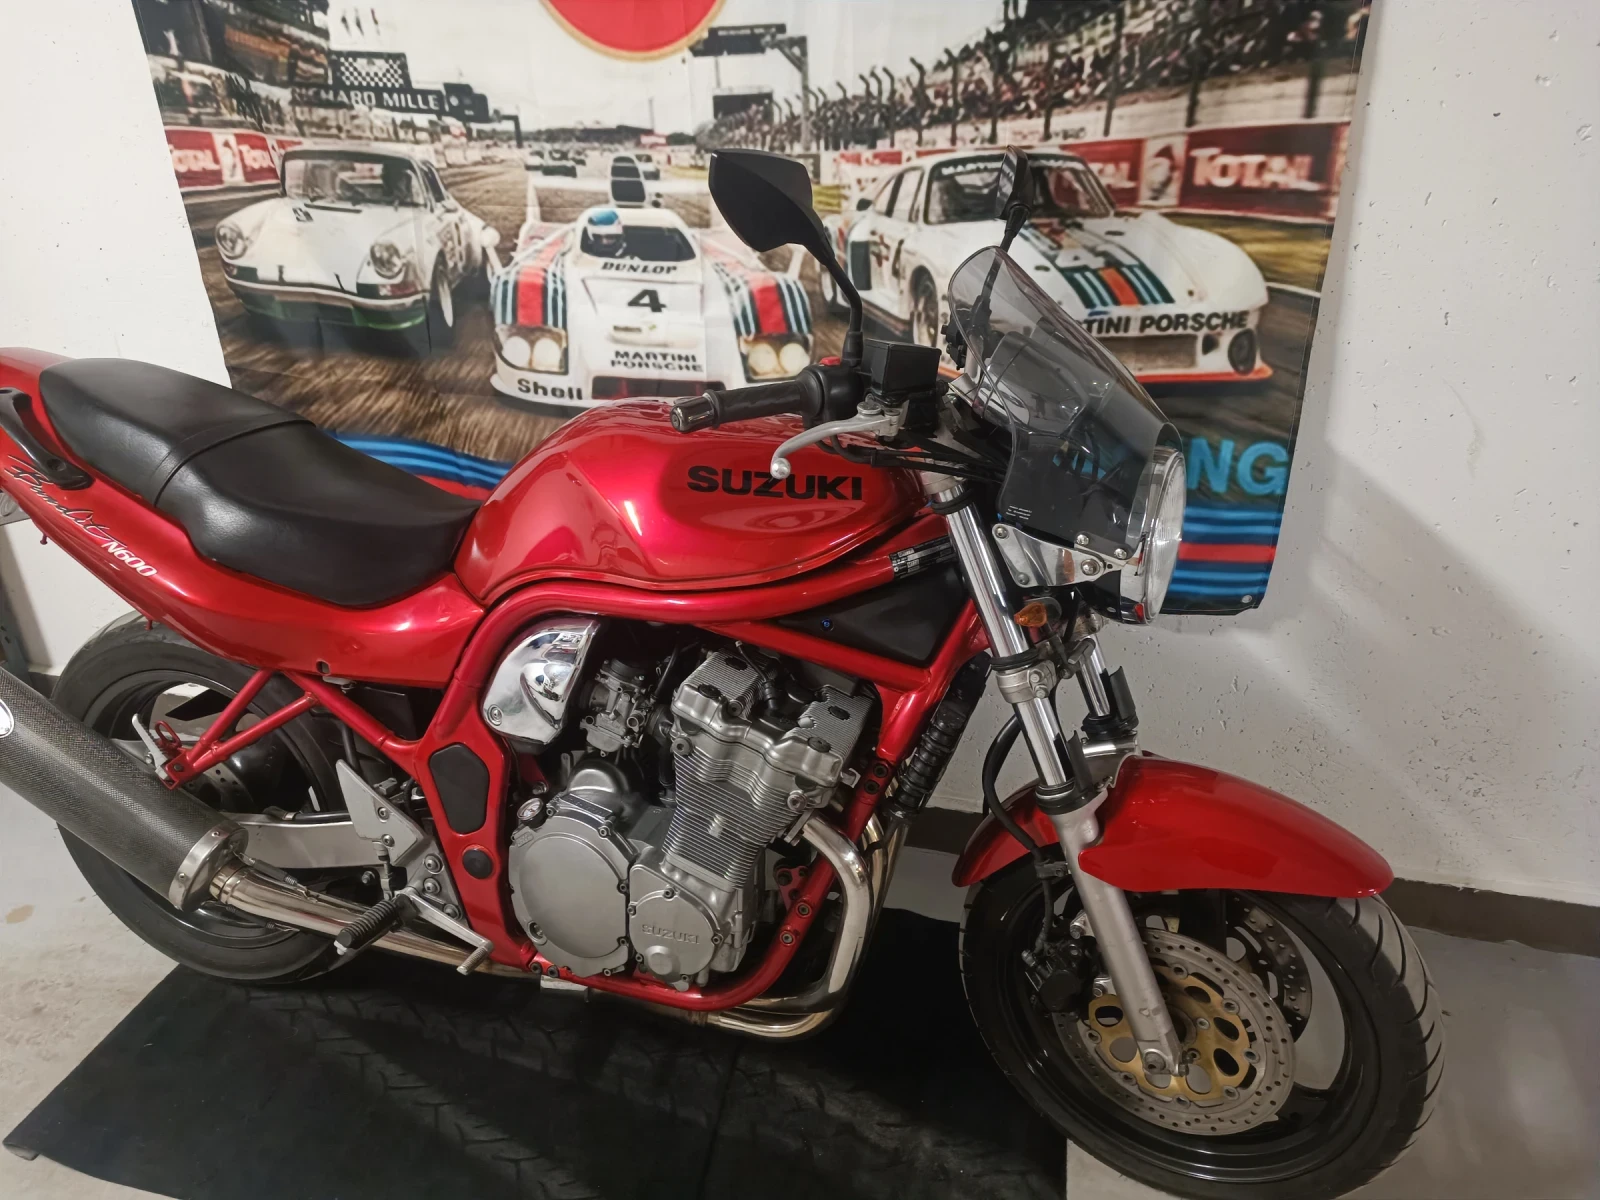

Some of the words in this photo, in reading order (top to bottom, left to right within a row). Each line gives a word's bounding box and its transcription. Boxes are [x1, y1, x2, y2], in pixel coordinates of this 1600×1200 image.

[383, 91, 440, 110] MILLE
[1190, 147, 1324, 191] TOTAL
[601, 261, 677, 275] DUNLOP
[627, 288, 667, 313] 4
[1081, 315, 1131, 335] TINI
[1139, 310, 1250, 334] PORSCHE
[610, 359, 704, 373] PORSCHE
[614, 350, 697, 363] MARTINI
[517, 378, 583, 400] Shell
[687, 465, 863, 501] SUZUKI
[101, 541, 158, 577] N600
[641, 922, 700, 945] SUZUKI
